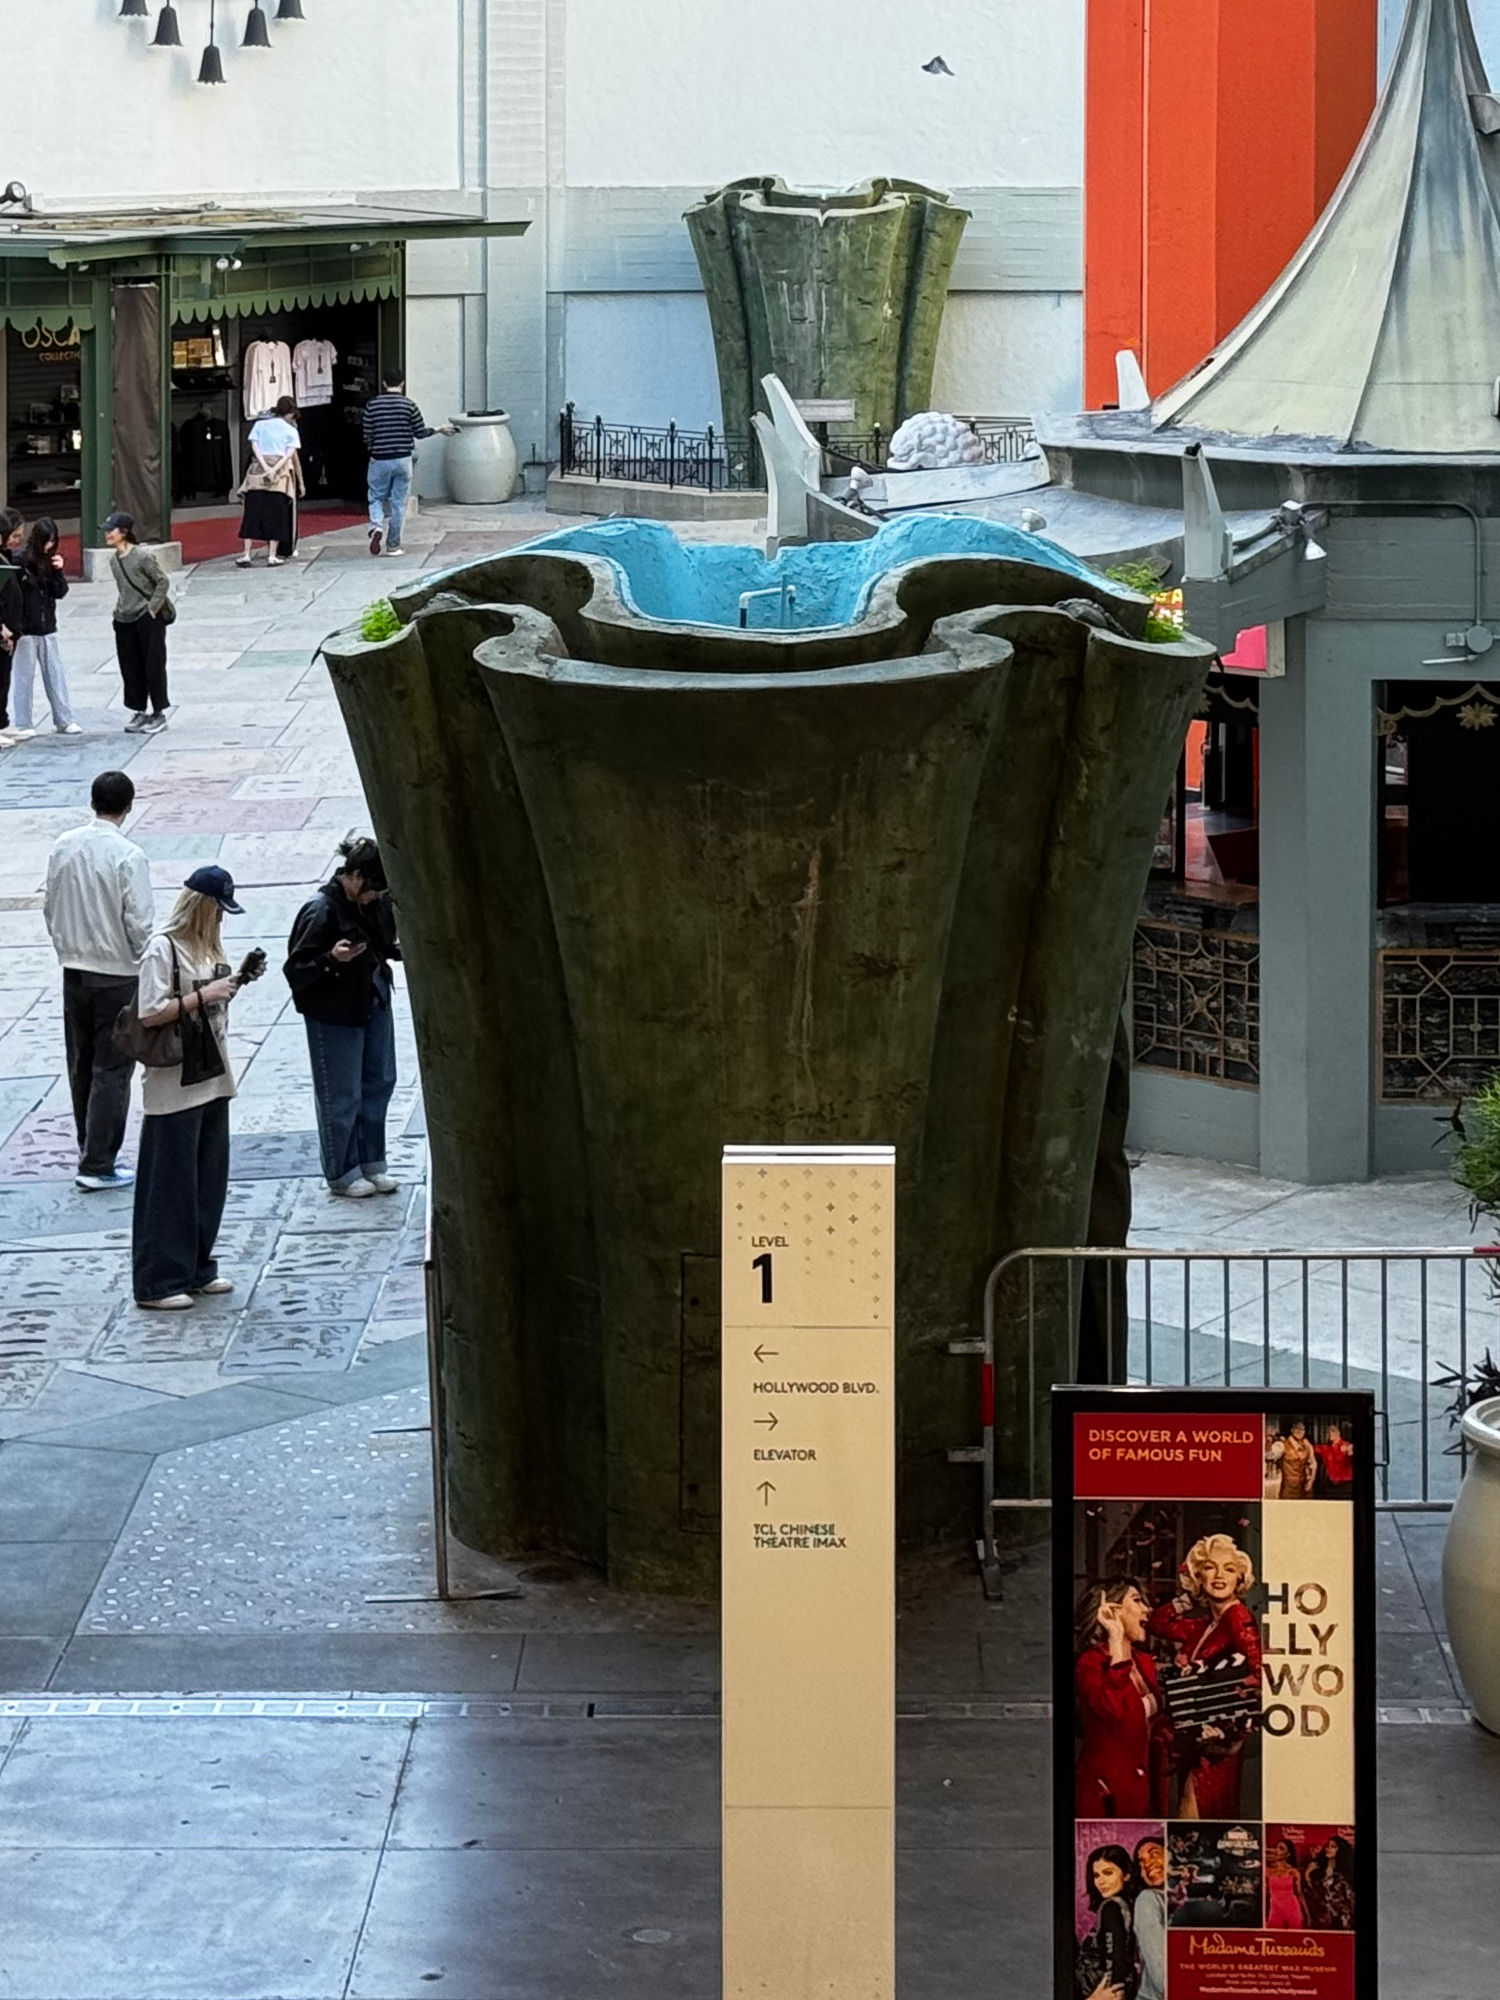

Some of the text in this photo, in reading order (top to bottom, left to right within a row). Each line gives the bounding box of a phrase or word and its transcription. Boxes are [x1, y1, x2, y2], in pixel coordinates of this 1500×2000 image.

[752, 1236, 789, 1247] LEVEL
[752, 1253, 773, 1303] 1
[753, 1382, 880, 1394] HOLLYWOOD BLVD.
[1088, 1429, 1254, 1444] DISCOVER A WORLD
[753, 1449, 817, 1461] ELEVATOR
[1088, 1448, 1222, 1462] OF FAMOUS FUN
[753, 1523, 835, 1535] TCL CHINESE
[753, 1537, 847, 1548] THEATRE IMAX
[1262, 1582, 1328, 1616] HO
[1262, 1622, 1339, 1656] LLY
[1262, 1663, 1344, 1697] WO
[1263, 1703, 1331, 1737] OD
[1189, 1932, 1326, 1957] Madame Tussauds
